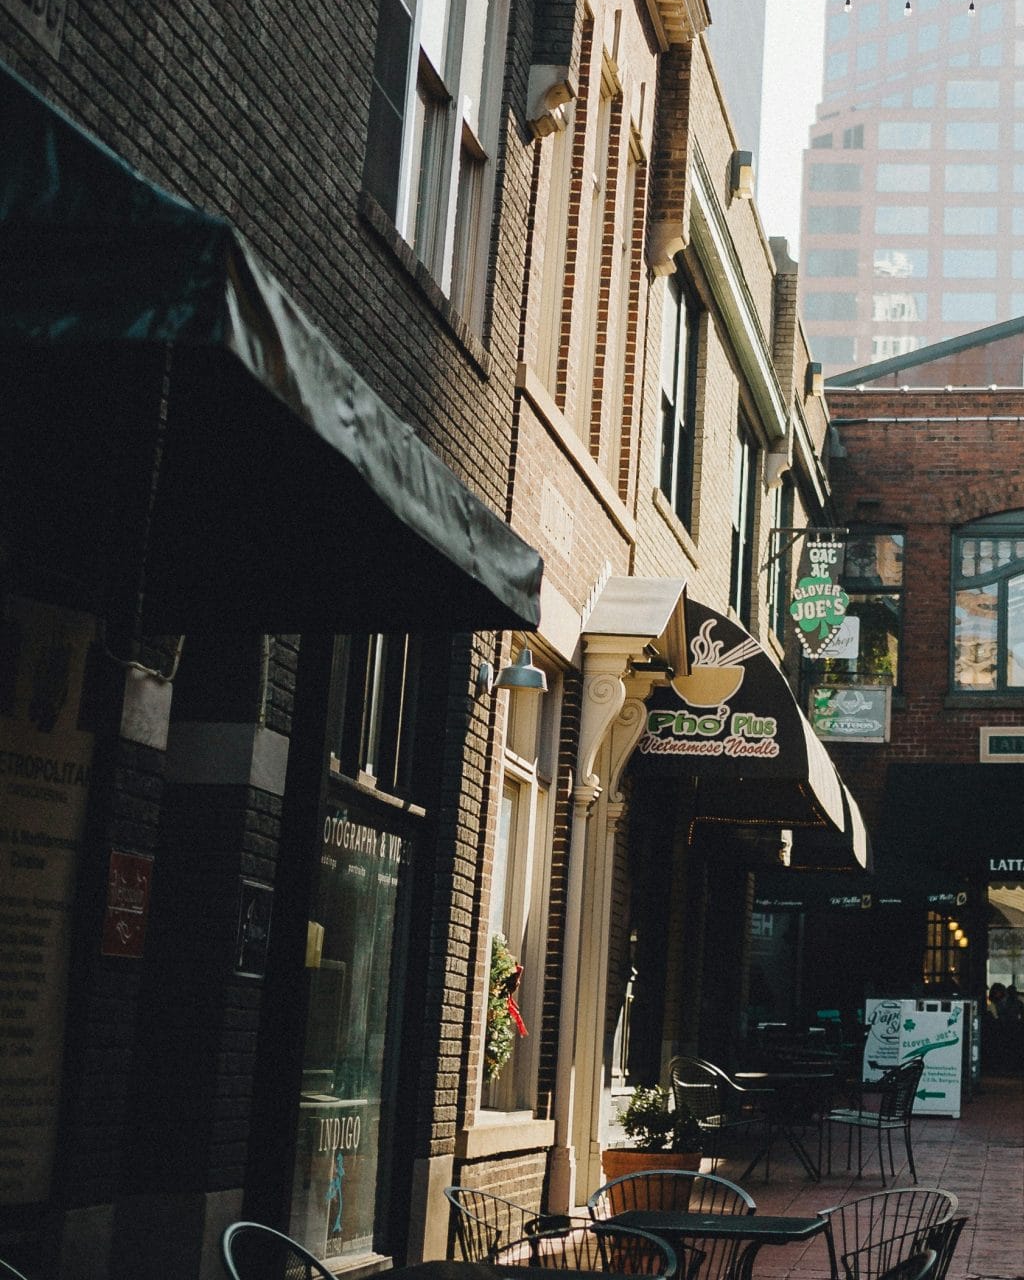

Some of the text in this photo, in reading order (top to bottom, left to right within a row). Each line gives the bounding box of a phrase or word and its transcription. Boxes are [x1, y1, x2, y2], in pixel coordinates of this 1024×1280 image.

[793, 584, 841, 601] CLOVER
[793, 598, 846, 621] JOE'S
[732, 713, 776, 737] Plus
[641, 735, 779, 757] Vietnamese Noodle
[324, 816, 377, 855] OTOGRAPHY
[318, 1116, 361, 1152] INDIGO
